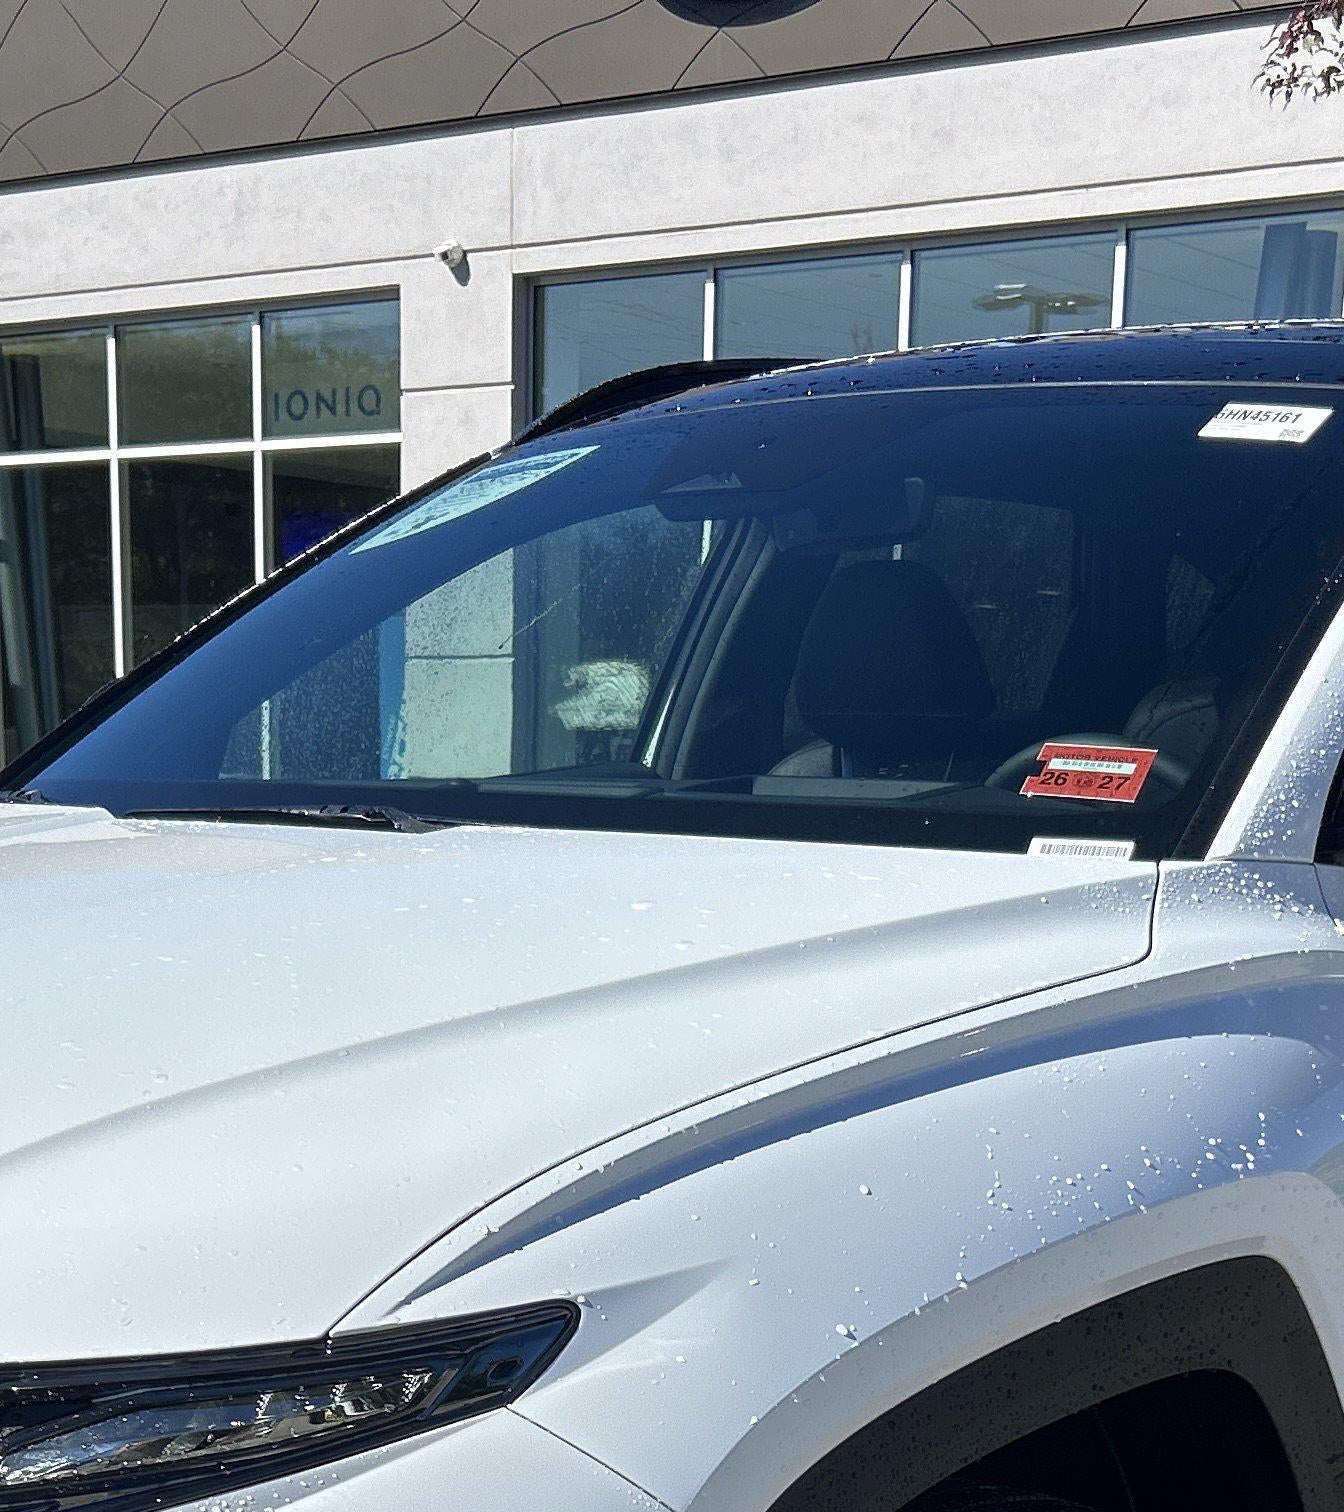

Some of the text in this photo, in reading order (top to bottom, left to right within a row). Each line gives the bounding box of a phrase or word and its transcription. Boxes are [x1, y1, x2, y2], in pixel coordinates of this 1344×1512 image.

[273, 384, 382, 422] IONIQ
[1038, 771, 1131, 790] 26 27
